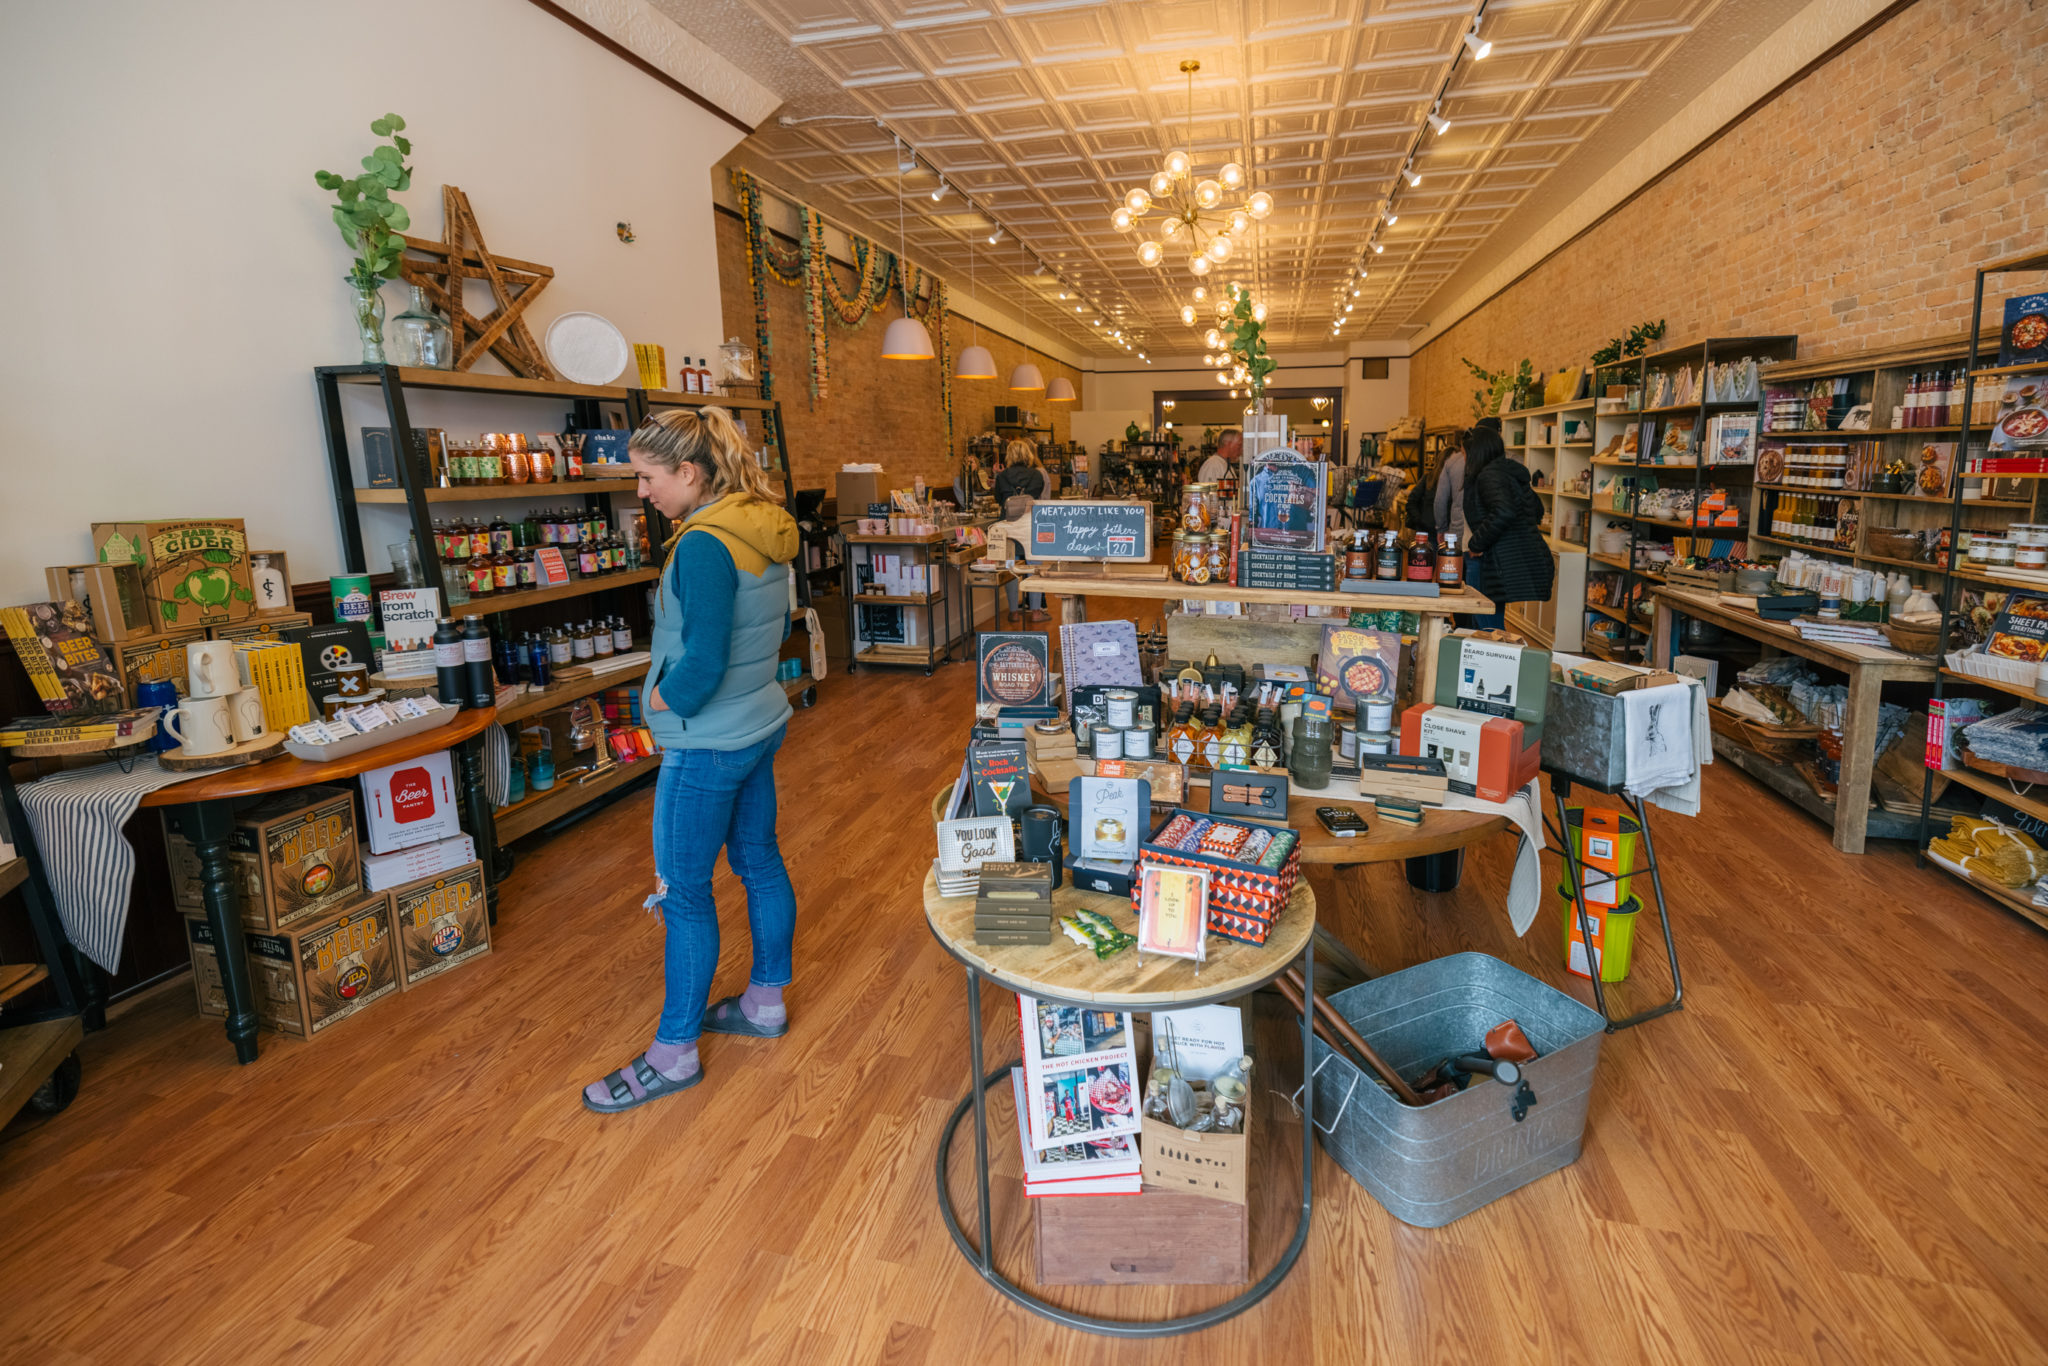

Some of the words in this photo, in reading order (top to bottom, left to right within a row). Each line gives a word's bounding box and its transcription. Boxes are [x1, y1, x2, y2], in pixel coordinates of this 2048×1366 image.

[1264, 493, 1305, 505] COCKTAILS
[1068, 506, 1094, 516] JUST
[1098, 507, 1120, 515] LIKE
[1124, 507, 1145, 516] YOU!
[181, 529, 215, 537] HARD
[1063, 520, 1099, 539] happy
[166, 535, 233, 553] CIDER
[1113, 543, 1127, 554] 20
[380, 590, 416, 601] Brew
[343, 601, 370, 610] BEER
[382, 601, 414, 611] from
[383, 609, 434, 622] scratch
[2008, 615, 2038, 628] SHEET
[2010, 624, 2046, 635] EVERYTHING
[58, 636, 93, 654] BEER
[11, 637, 25, 654] BEER
[21, 656, 36, 675] BITES
[20, 637, 34, 654] BEER
[29, 656, 44, 675] BITES
[29, 636, 43, 654] BEER
[39, 656, 54, 675] BITES
[64, 648, 100, 666] BITES
[1464, 648, 1485, 656] BEARD
[1485, 651, 1517, 662] SURVIVAL
[992, 672, 1036, 682] WHISKEY
[26, 730, 54, 738] BEER
[54, 727, 82, 736] BITES
[1424, 722, 1445, 732] CLOSE
[1445, 727, 1467, 736] SHAVE
[52, 734, 81, 743] BITES
[988, 758, 1009, 767] Rock
[981, 765, 1018, 777] Cocktails
[395, 787, 429, 803] Beer
[283, 815, 342, 867] BEER
[955, 829, 973, 842] YOU
[974, 827, 997, 841] LOOK
[961, 842, 996, 863] Good
[413, 882, 471, 930] BEER
[317, 917, 378, 972] BEER
[1070, 1057, 1099, 1065] CHICKEN
[1100, 1052, 1128, 1060] PROJECT
